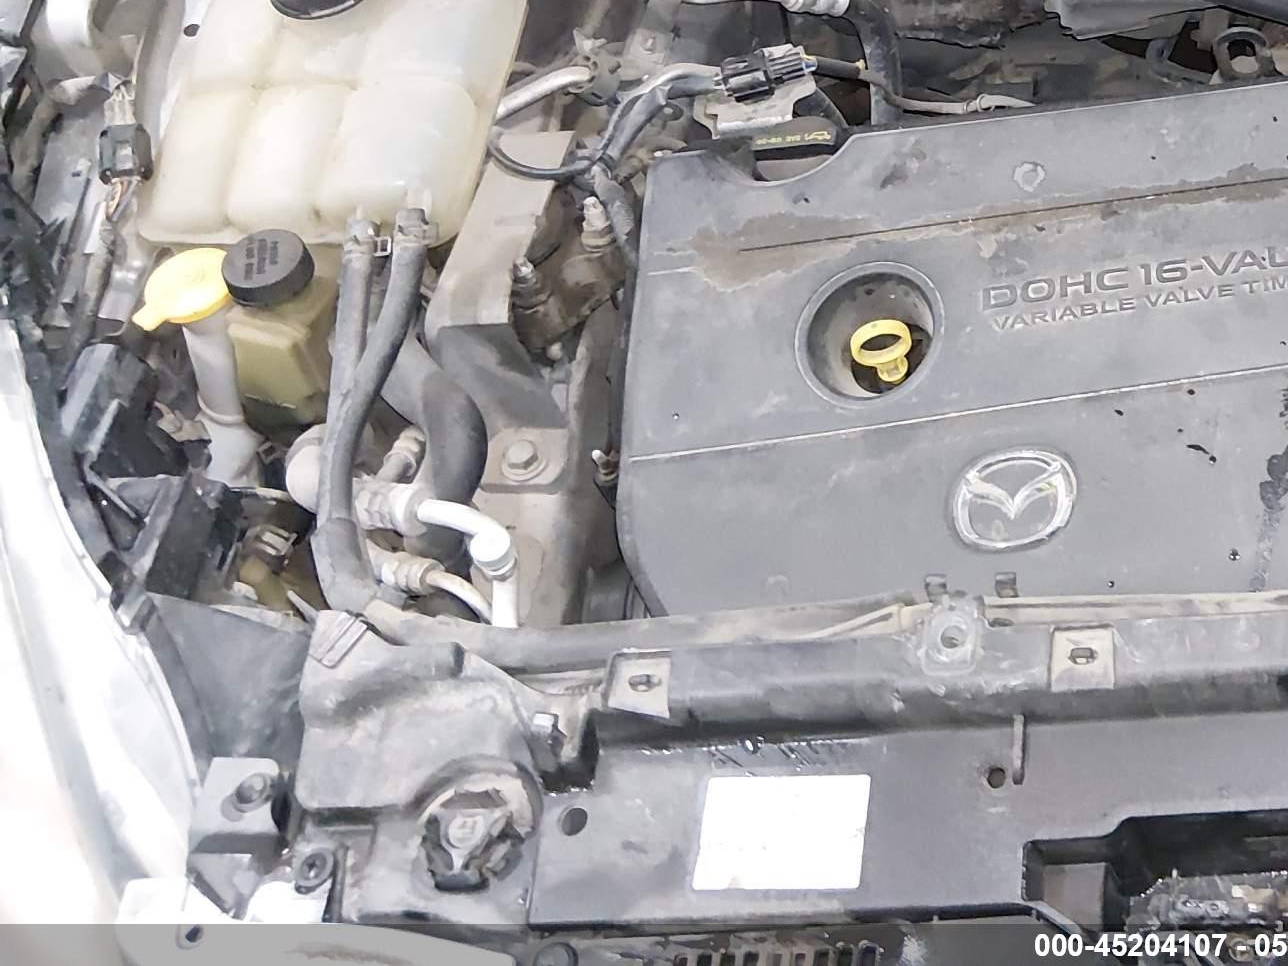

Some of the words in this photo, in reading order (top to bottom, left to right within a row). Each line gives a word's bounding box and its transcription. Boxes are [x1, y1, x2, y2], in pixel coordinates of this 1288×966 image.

[982, 267, 1129, 312] DOHC
[991, 297, 1136, 331] VARIABLE
[1144, 283, 1235, 309] VALVE
